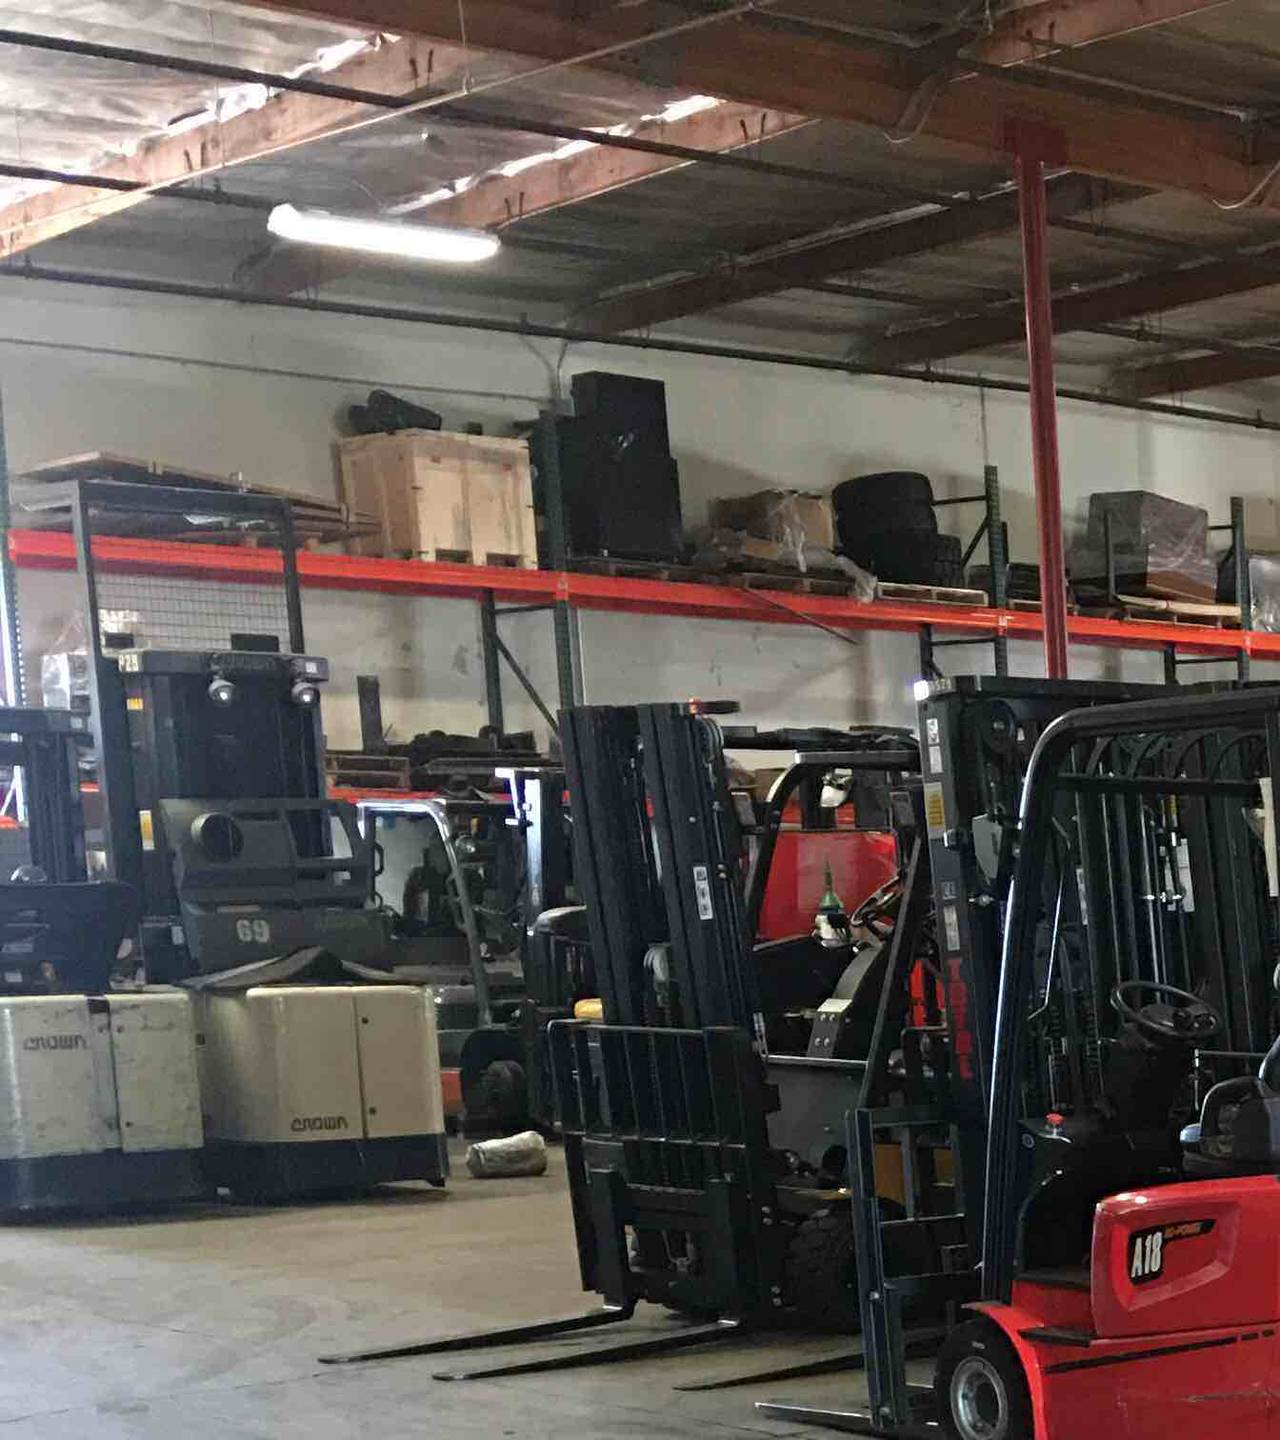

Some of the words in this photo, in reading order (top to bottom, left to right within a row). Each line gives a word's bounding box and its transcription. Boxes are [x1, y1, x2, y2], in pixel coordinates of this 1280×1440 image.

[23, 1034, 88, 1050] CROWN
[290, 1116, 349, 1132] CROWN
[1131, 1231, 1163, 1278] A18
